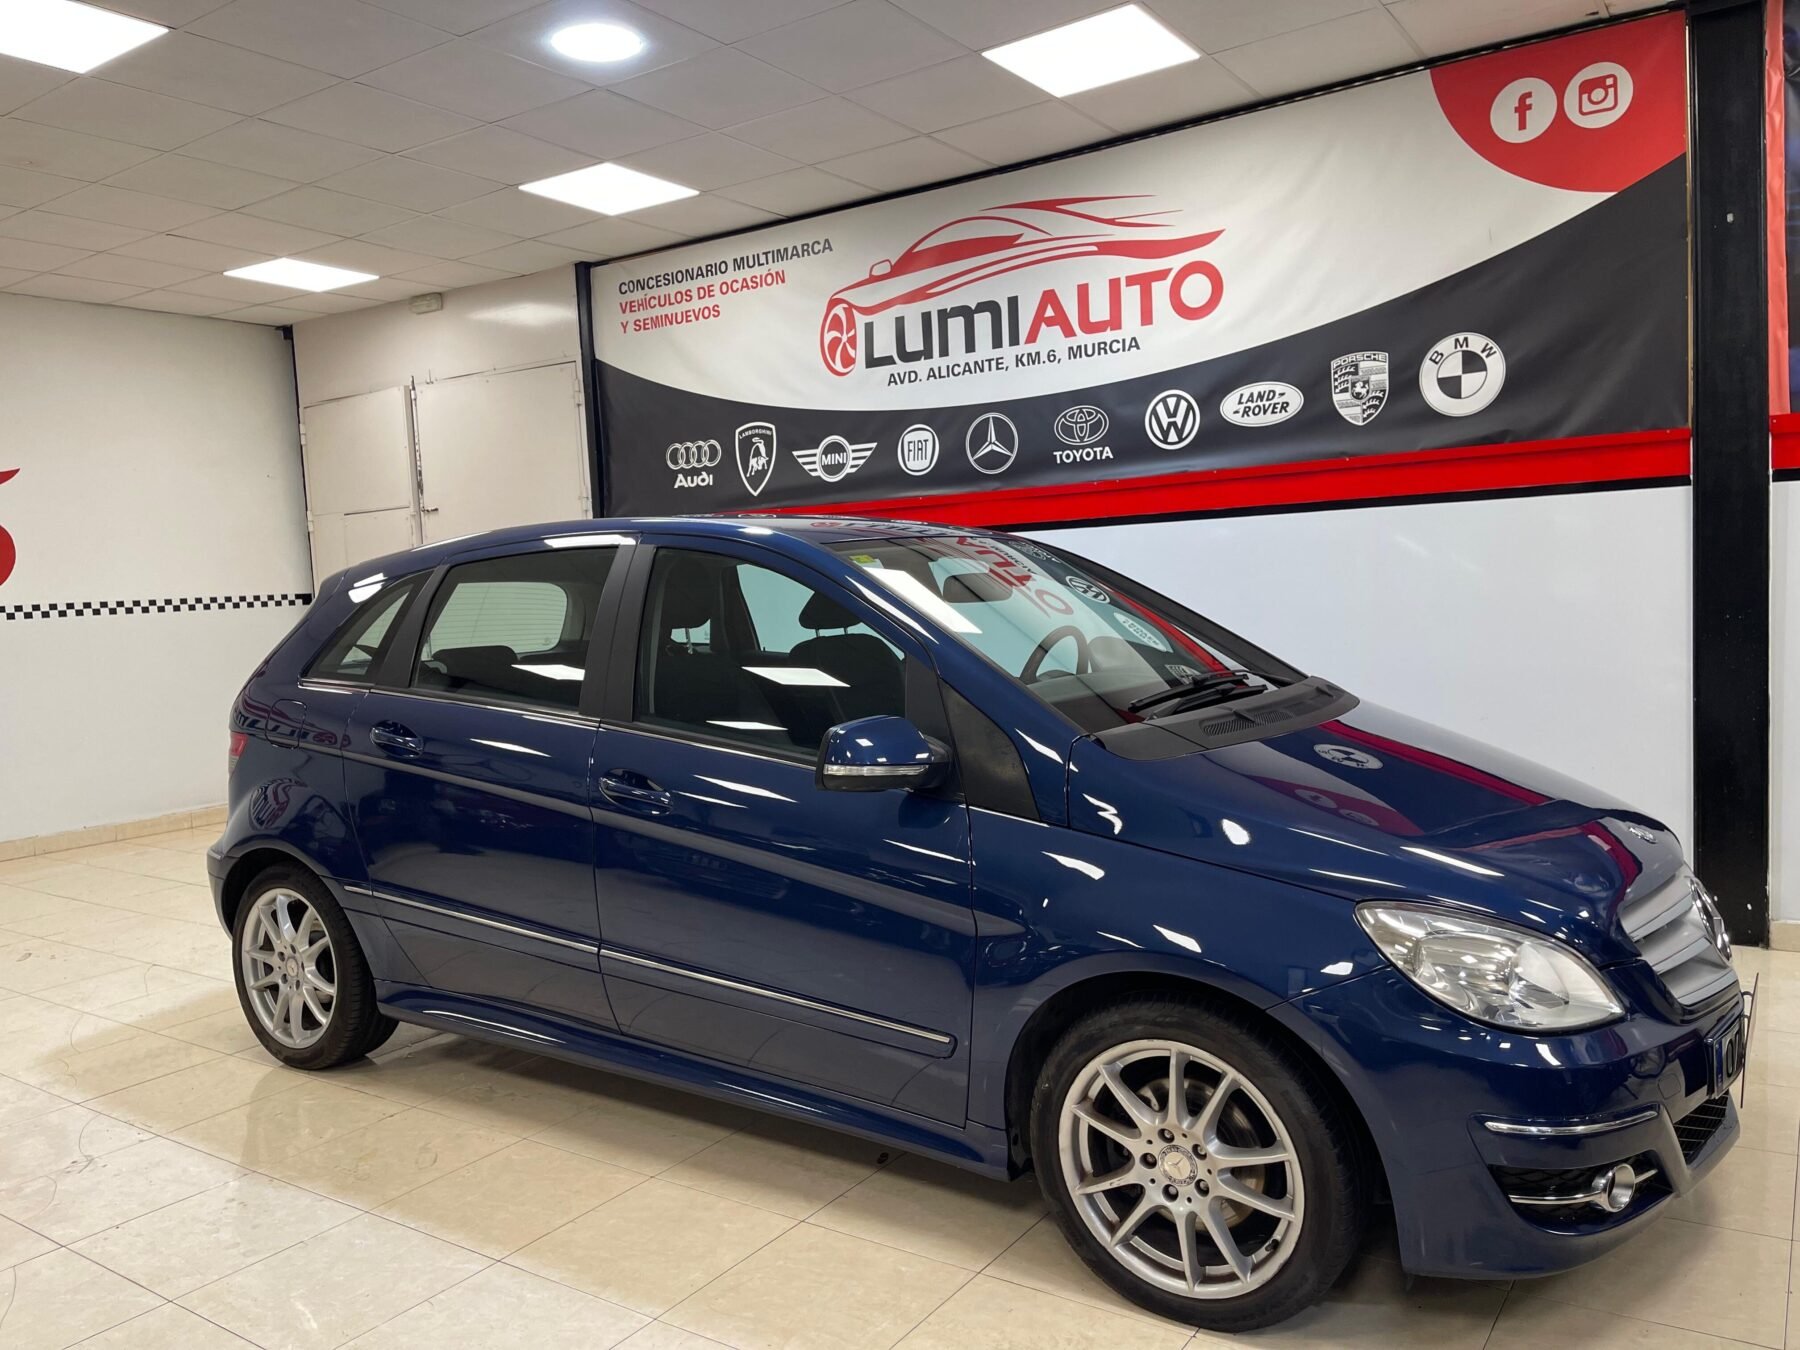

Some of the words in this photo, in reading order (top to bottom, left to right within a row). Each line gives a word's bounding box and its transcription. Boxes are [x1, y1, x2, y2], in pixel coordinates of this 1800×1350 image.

[618, 260, 729, 295] CONCESIONARIO
[733, 238, 833, 271] MULTIMARCA
[619, 289, 693, 314] VEHÍCULOS
[697, 285, 715, 300] DE
[719, 268, 786, 296] OCASIÓN
[620, 321, 629, 334] Y
[633, 304, 721, 332] SEMINUEVOS
[887, 370, 923, 387] AVD.
[926, 357, 1010, 382] ALICANTE,
[1015, 348, 1062, 368] KM.6,
[1067, 336, 1141, 361] MURCIA
[1333, 352, 1387, 369] PORSCHE
[821, 453, 847, 466] MINI
[907, 438, 929, 462] FIAT
[1053, 446, 1114, 464] TOYOTA
[674, 471, 713, 489] Audi
